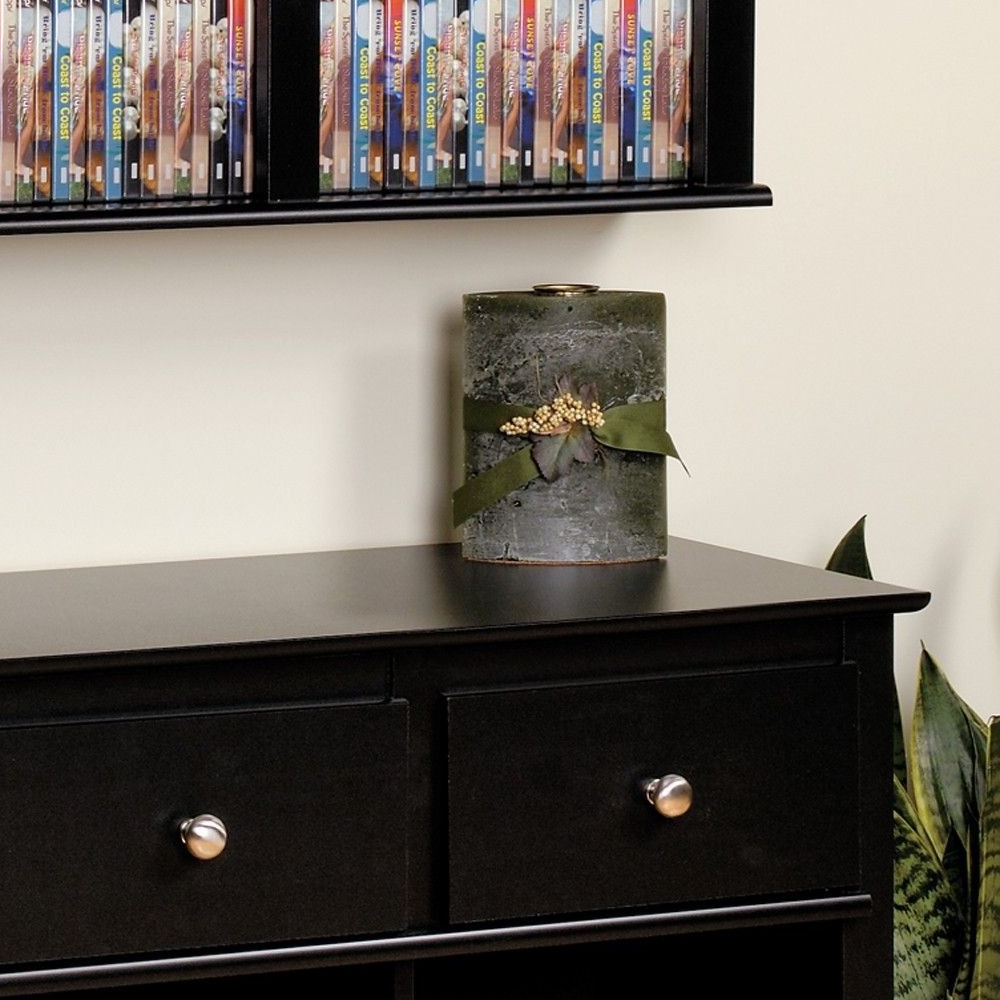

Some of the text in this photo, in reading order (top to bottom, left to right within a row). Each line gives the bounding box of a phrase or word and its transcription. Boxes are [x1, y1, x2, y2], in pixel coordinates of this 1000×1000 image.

[60, 54, 71, 87] Coast
[112, 55, 123, 88] Coast
[360, 46, 370, 78] Coast
[428, 46, 437, 77] Coast
[476, 41, 486, 72] Coast
[594, 41, 604, 72] Coast
[644, 40, 653, 71] Coast
[360, 98, 369, 130] Coast
[426, 97, 436, 128] Coast
[476, 92, 485, 124] Coast
[592, 92, 602, 124] Coast
[642, 90, 652, 121] Coast
[60, 108, 71, 140] Coast
[112, 108, 123, 140] Coast
